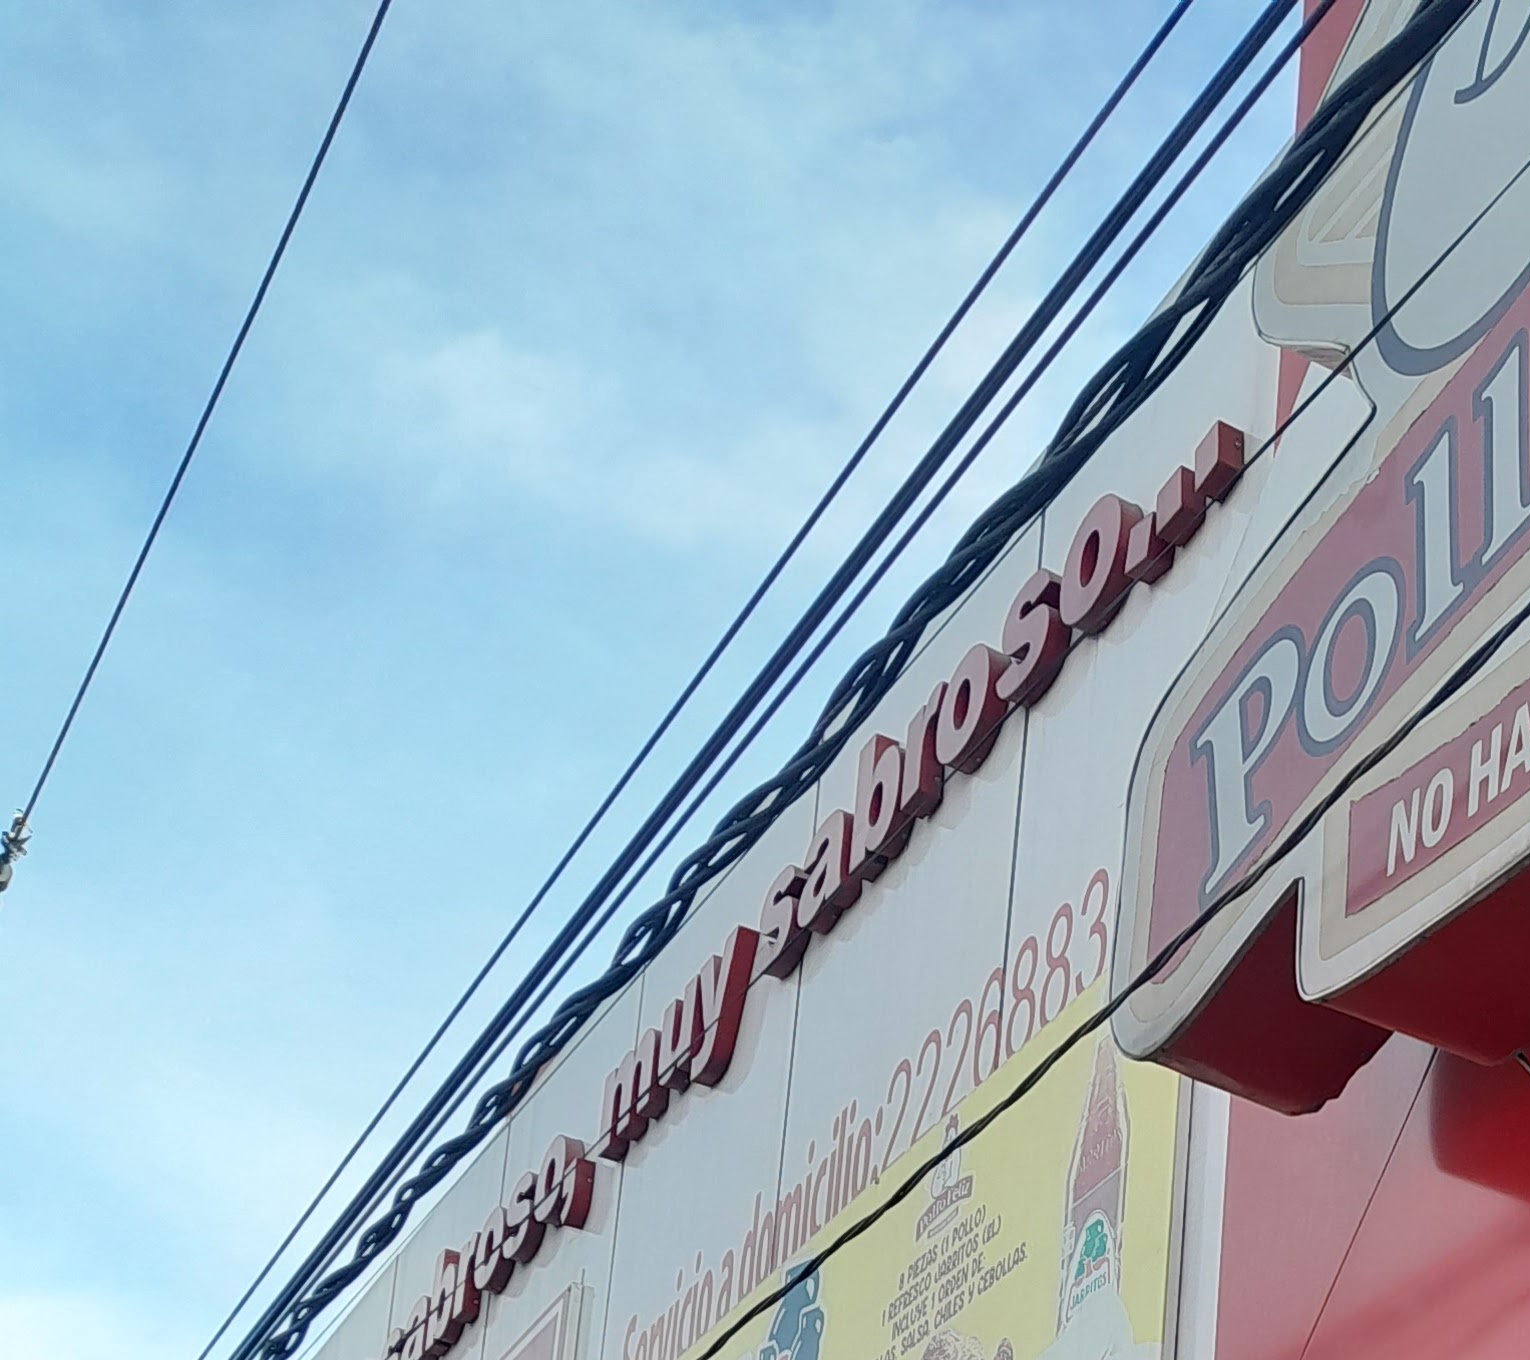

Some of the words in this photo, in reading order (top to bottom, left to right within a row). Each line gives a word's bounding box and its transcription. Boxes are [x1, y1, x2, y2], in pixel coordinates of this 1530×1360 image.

[1388, 771, 1452, 875] NO
[598, 925, 760, 1162] muy
[885, 868, 1109, 1173] 2226883
